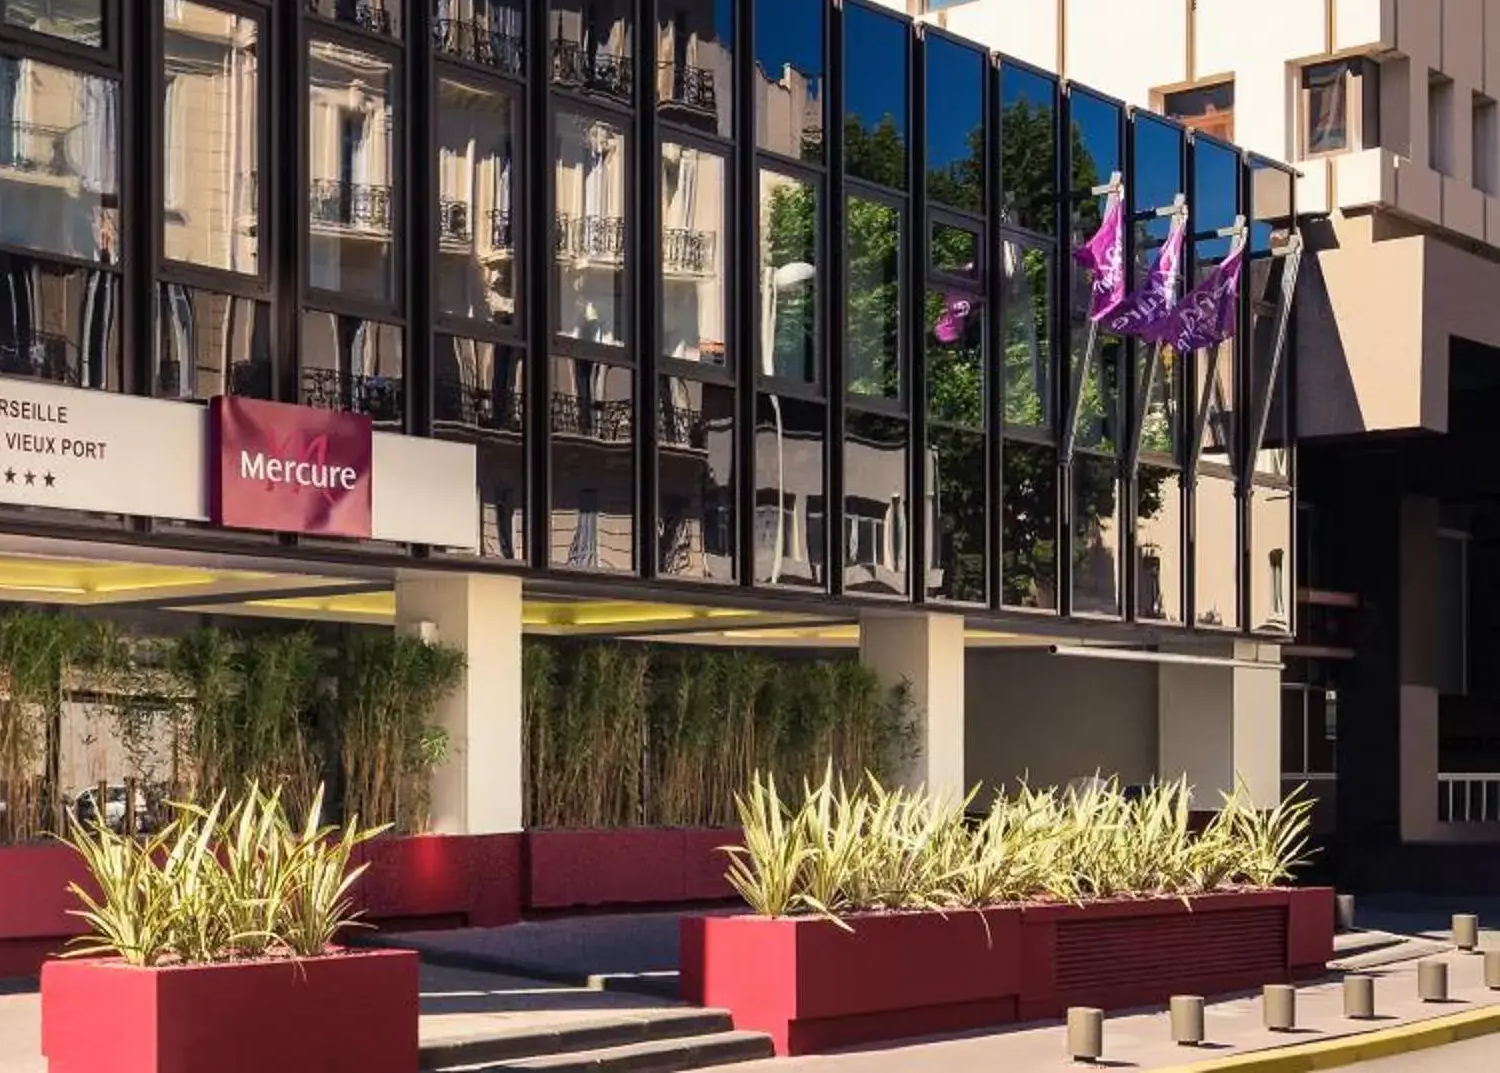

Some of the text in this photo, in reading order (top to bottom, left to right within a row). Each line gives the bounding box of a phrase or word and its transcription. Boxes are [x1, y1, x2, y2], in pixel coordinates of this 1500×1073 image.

[5, 431, 57, 455] VIEUX
[61, 438, 107, 460] PORT
[240, 449, 357, 490] Mercure
